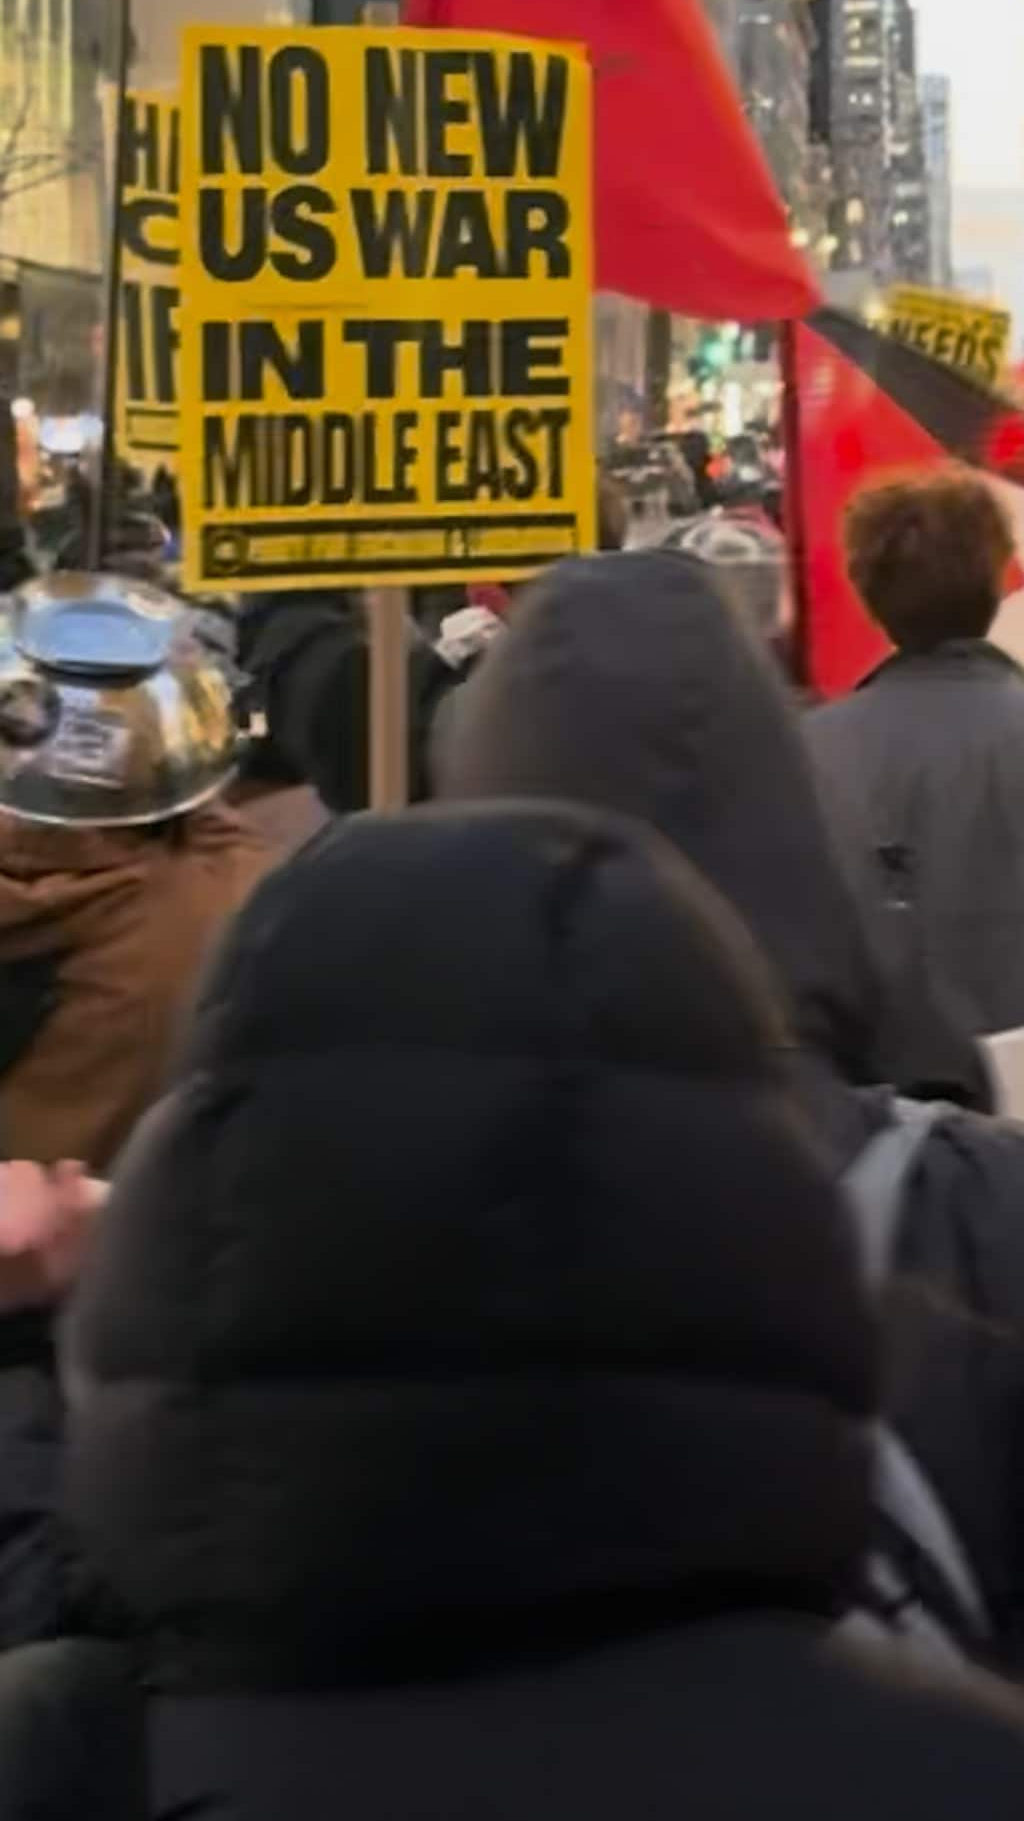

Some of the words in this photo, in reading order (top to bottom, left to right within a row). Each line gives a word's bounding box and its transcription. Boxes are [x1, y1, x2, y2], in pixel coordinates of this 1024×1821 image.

[201, 45, 329, 175] NO
[365, 47, 569, 177] NEW
[200, 186, 336, 281] US
[349, 189, 570, 279] WAR
[202, 319, 324, 400] IN
[342, 317, 570, 399] THE
[203, 411, 418, 508] MIDDLE
[435, 407, 570, 501] EAST
